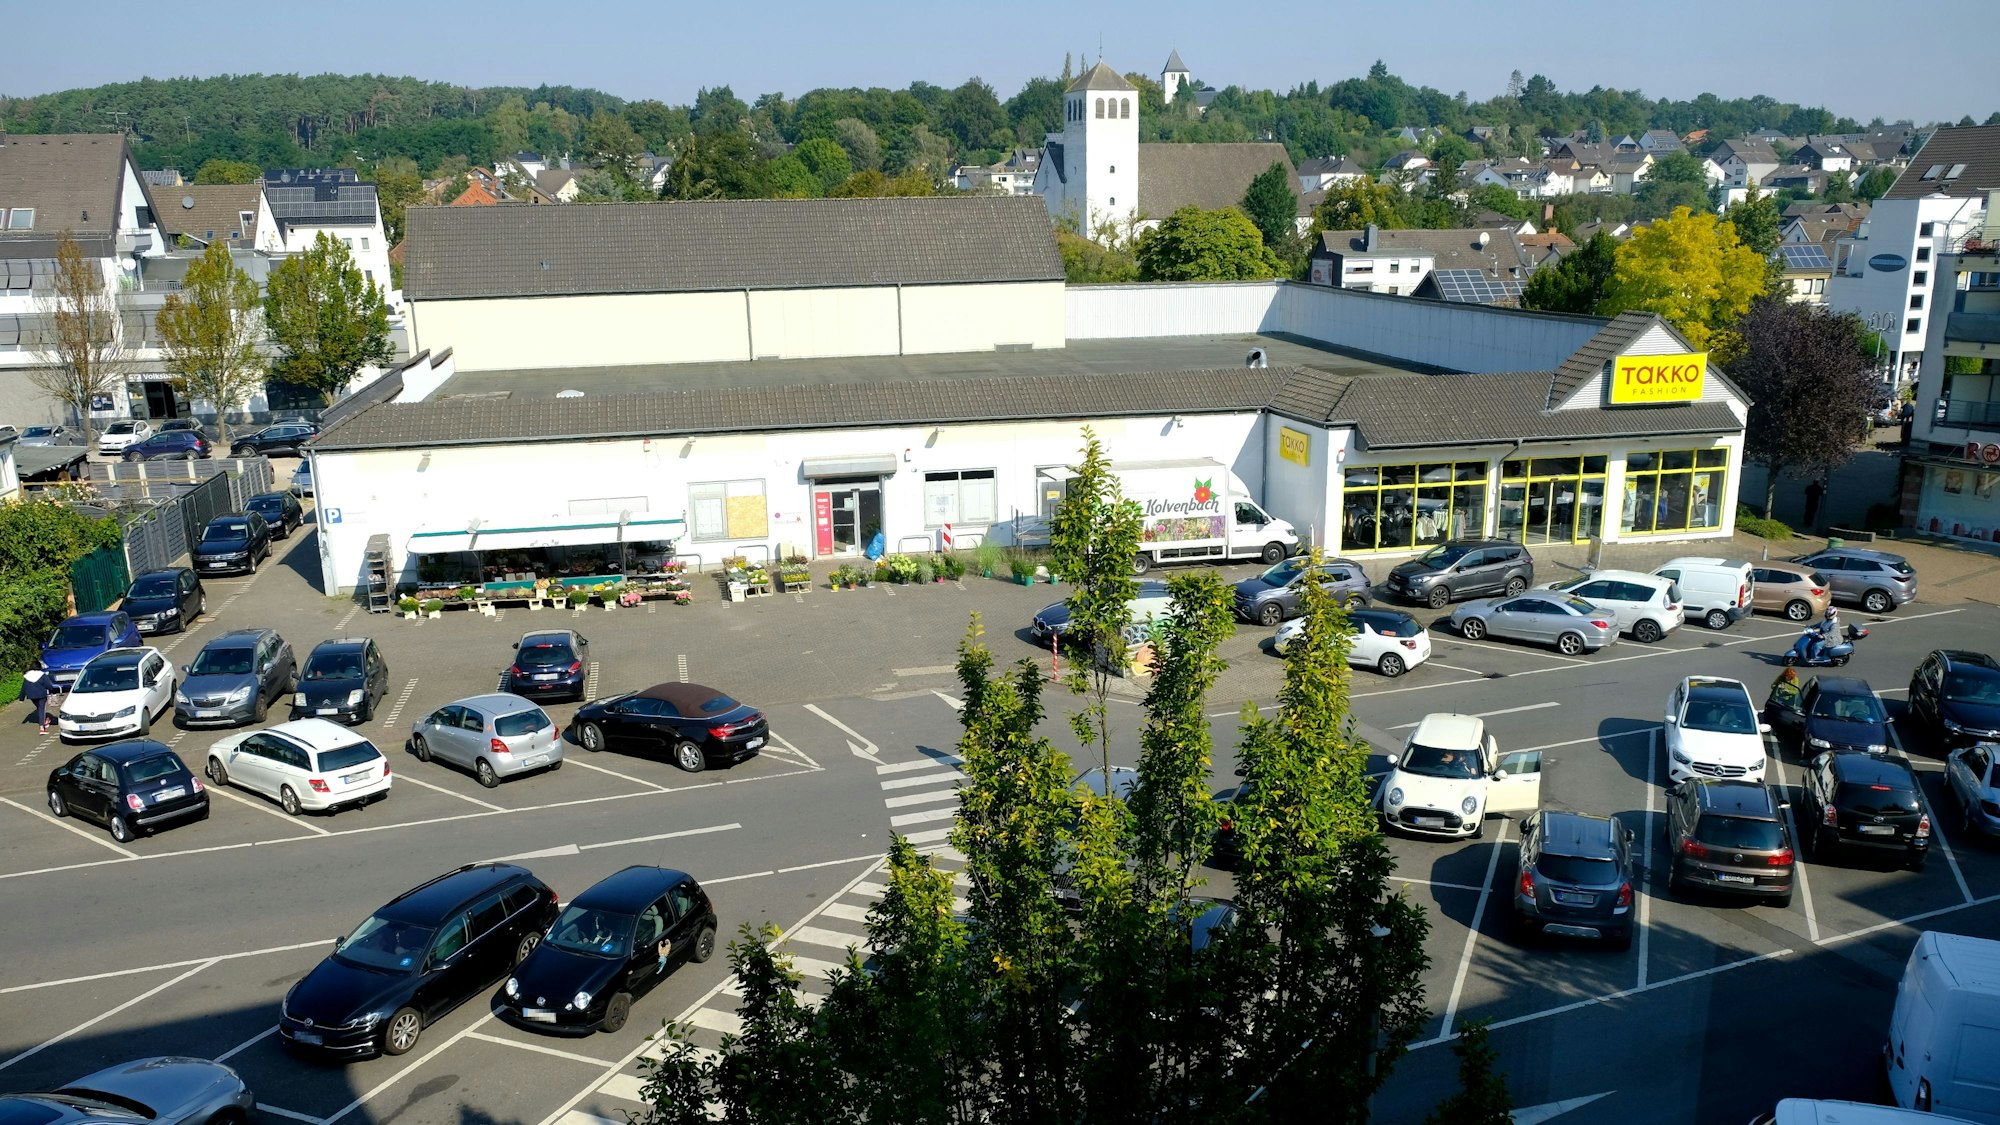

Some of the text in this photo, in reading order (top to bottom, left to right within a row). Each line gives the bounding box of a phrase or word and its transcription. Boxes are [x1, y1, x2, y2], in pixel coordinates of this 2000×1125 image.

[1632, 387, 1687, 395] FASHION
[1146, 497, 1219, 516] Kolvenbach
[328, 509, 340, 524] P
